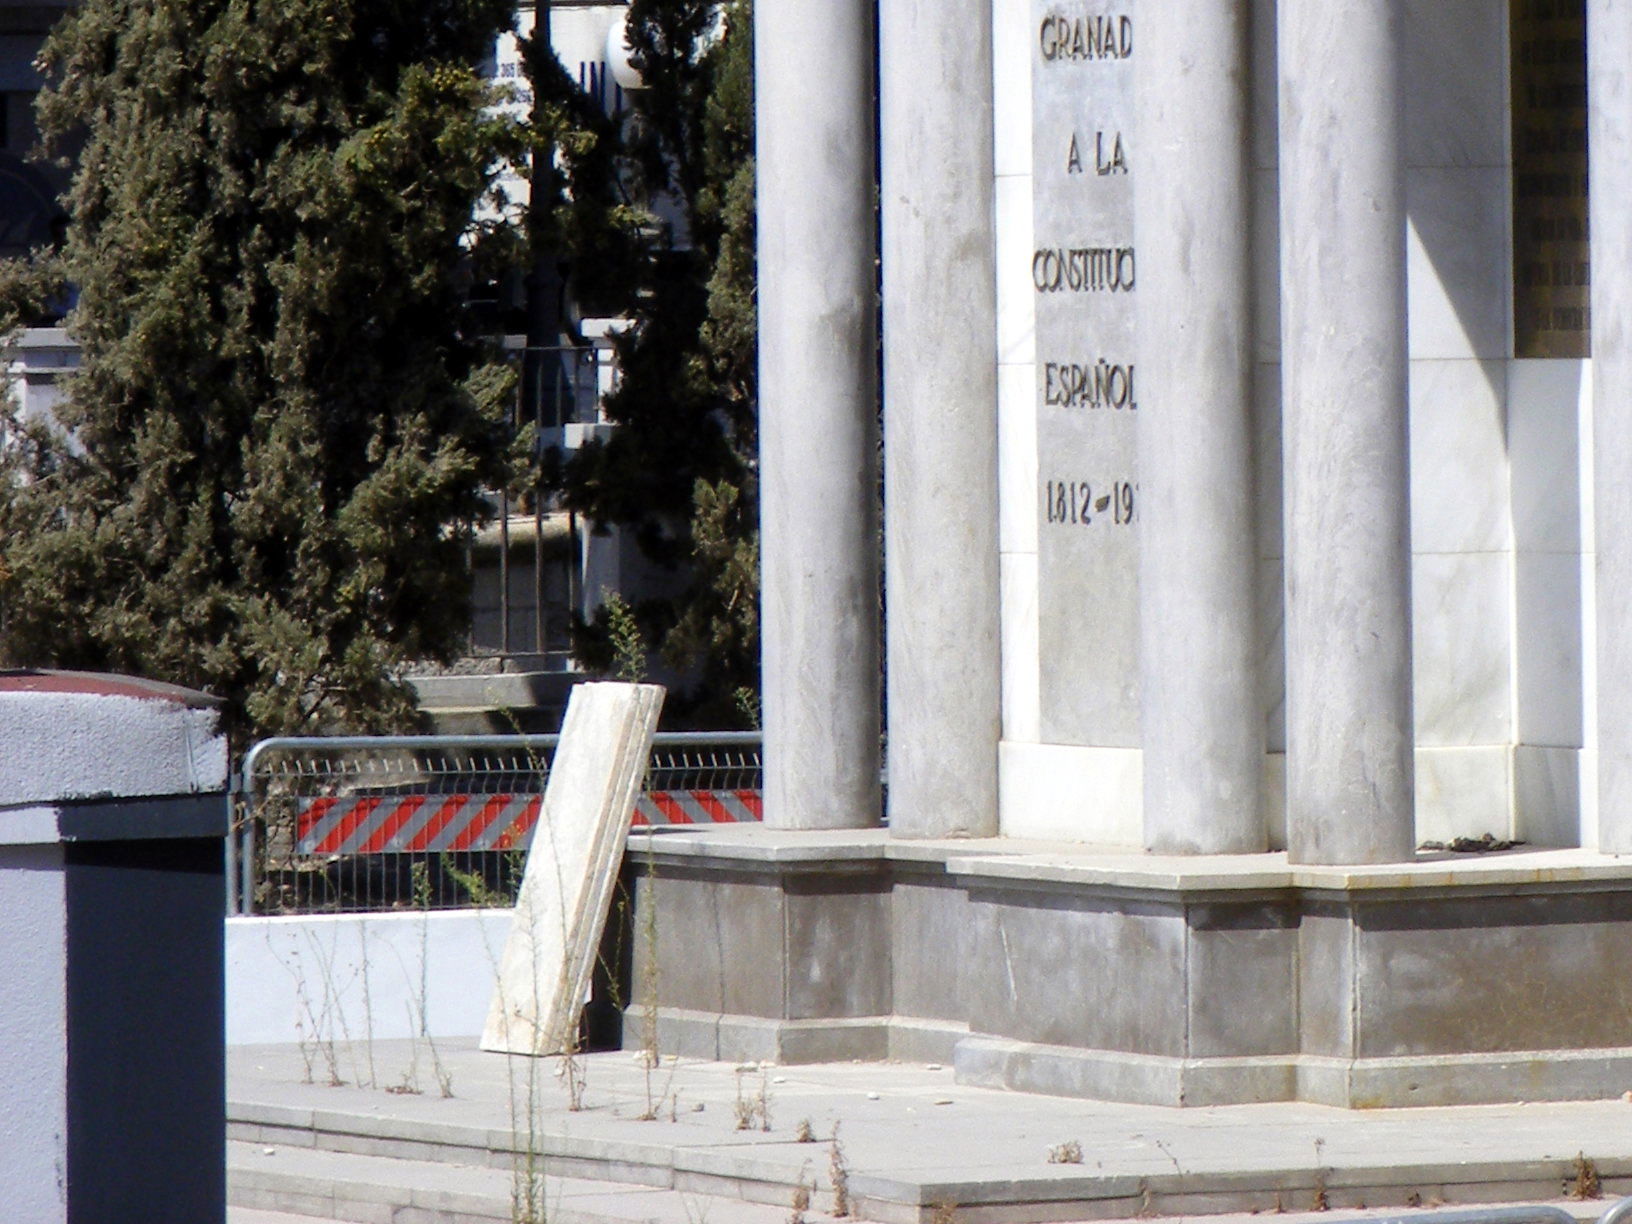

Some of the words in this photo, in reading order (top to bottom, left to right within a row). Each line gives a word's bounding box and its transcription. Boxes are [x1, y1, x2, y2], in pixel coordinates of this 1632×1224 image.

[1067, 131, 1082, 174] A
[1096, 131, 1128, 176] LA
[1046, 480, 1139, 526] 1812-19
